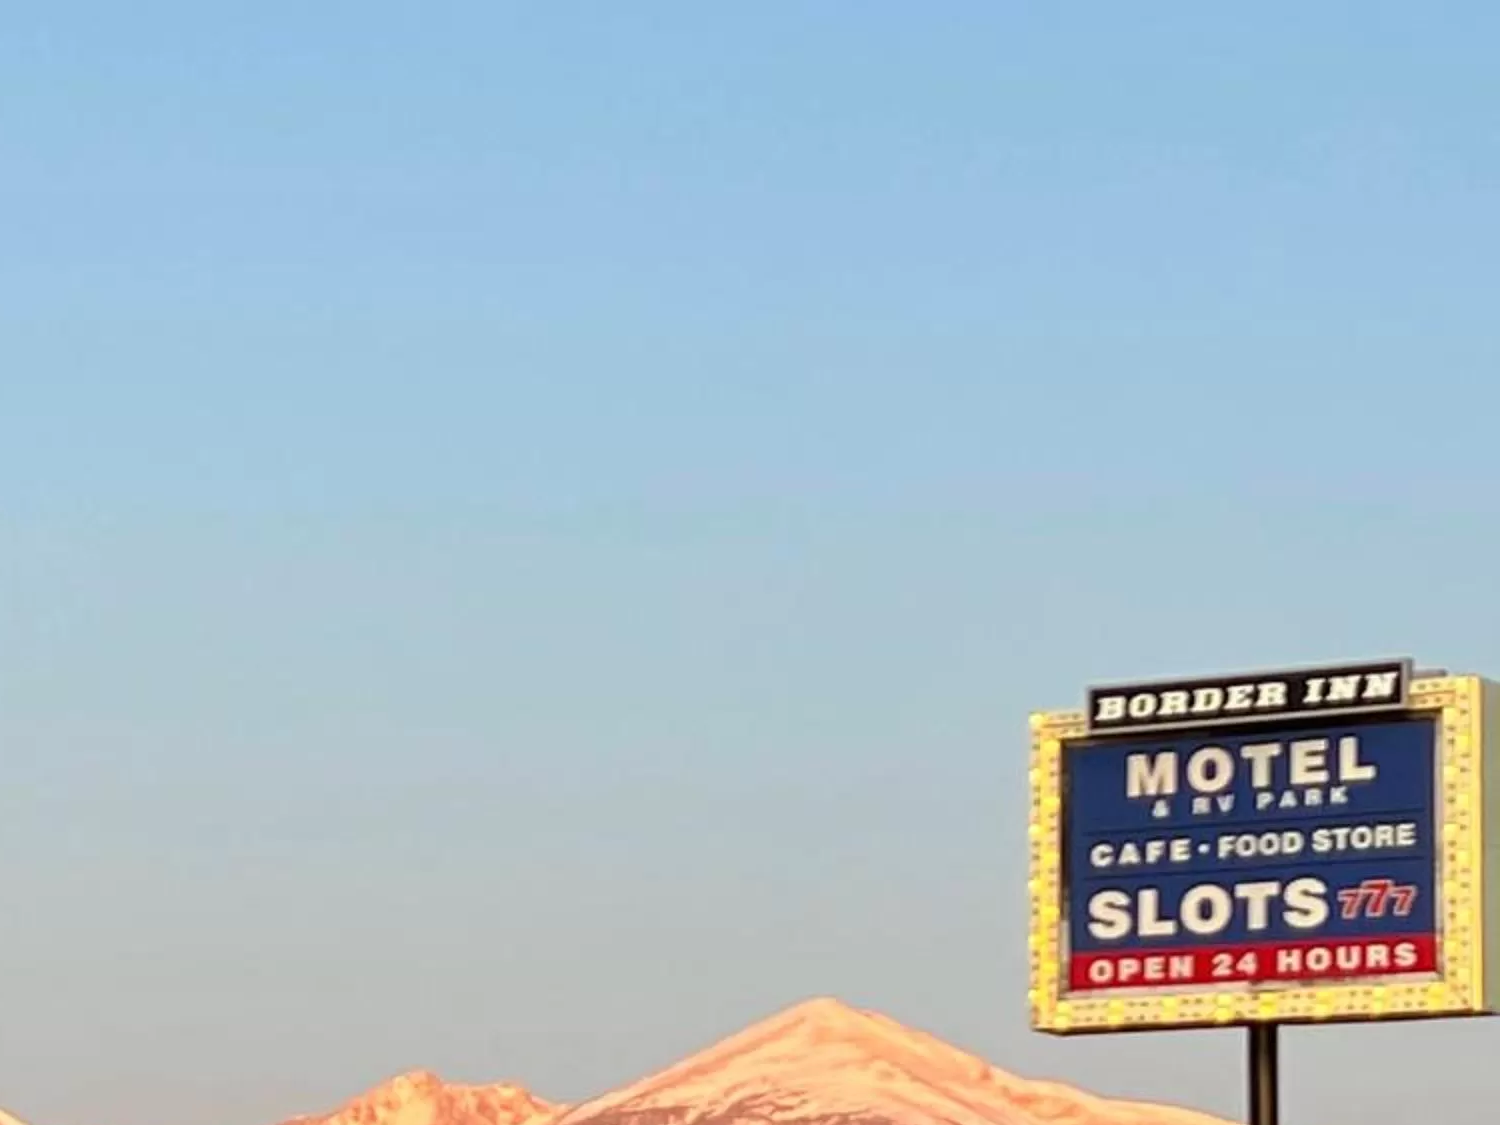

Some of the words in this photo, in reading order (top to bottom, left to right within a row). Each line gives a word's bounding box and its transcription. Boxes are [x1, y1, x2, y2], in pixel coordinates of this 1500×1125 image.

[1096, 681, 1287, 721] BORDER
[1304, 671, 1399, 704] INN
[1127, 736, 1376, 798] MOTEL
[1192, 794, 1235, 815] RV
[1256, 786, 1348, 810] PARK
[1090, 838, 1191, 867] CAFE
[1217, 831, 1304, 859] FOOD
[1312, 823, 1416, 851] STORE
[1088, 878, 1328, 940] SLOTS
[1338, 879, 1417, 919] 777
[1089, 954, 1194, 983] OPEN
[1212, 952, 1259, 977] 24
[1278, 943, 1418, 972] HOURS
